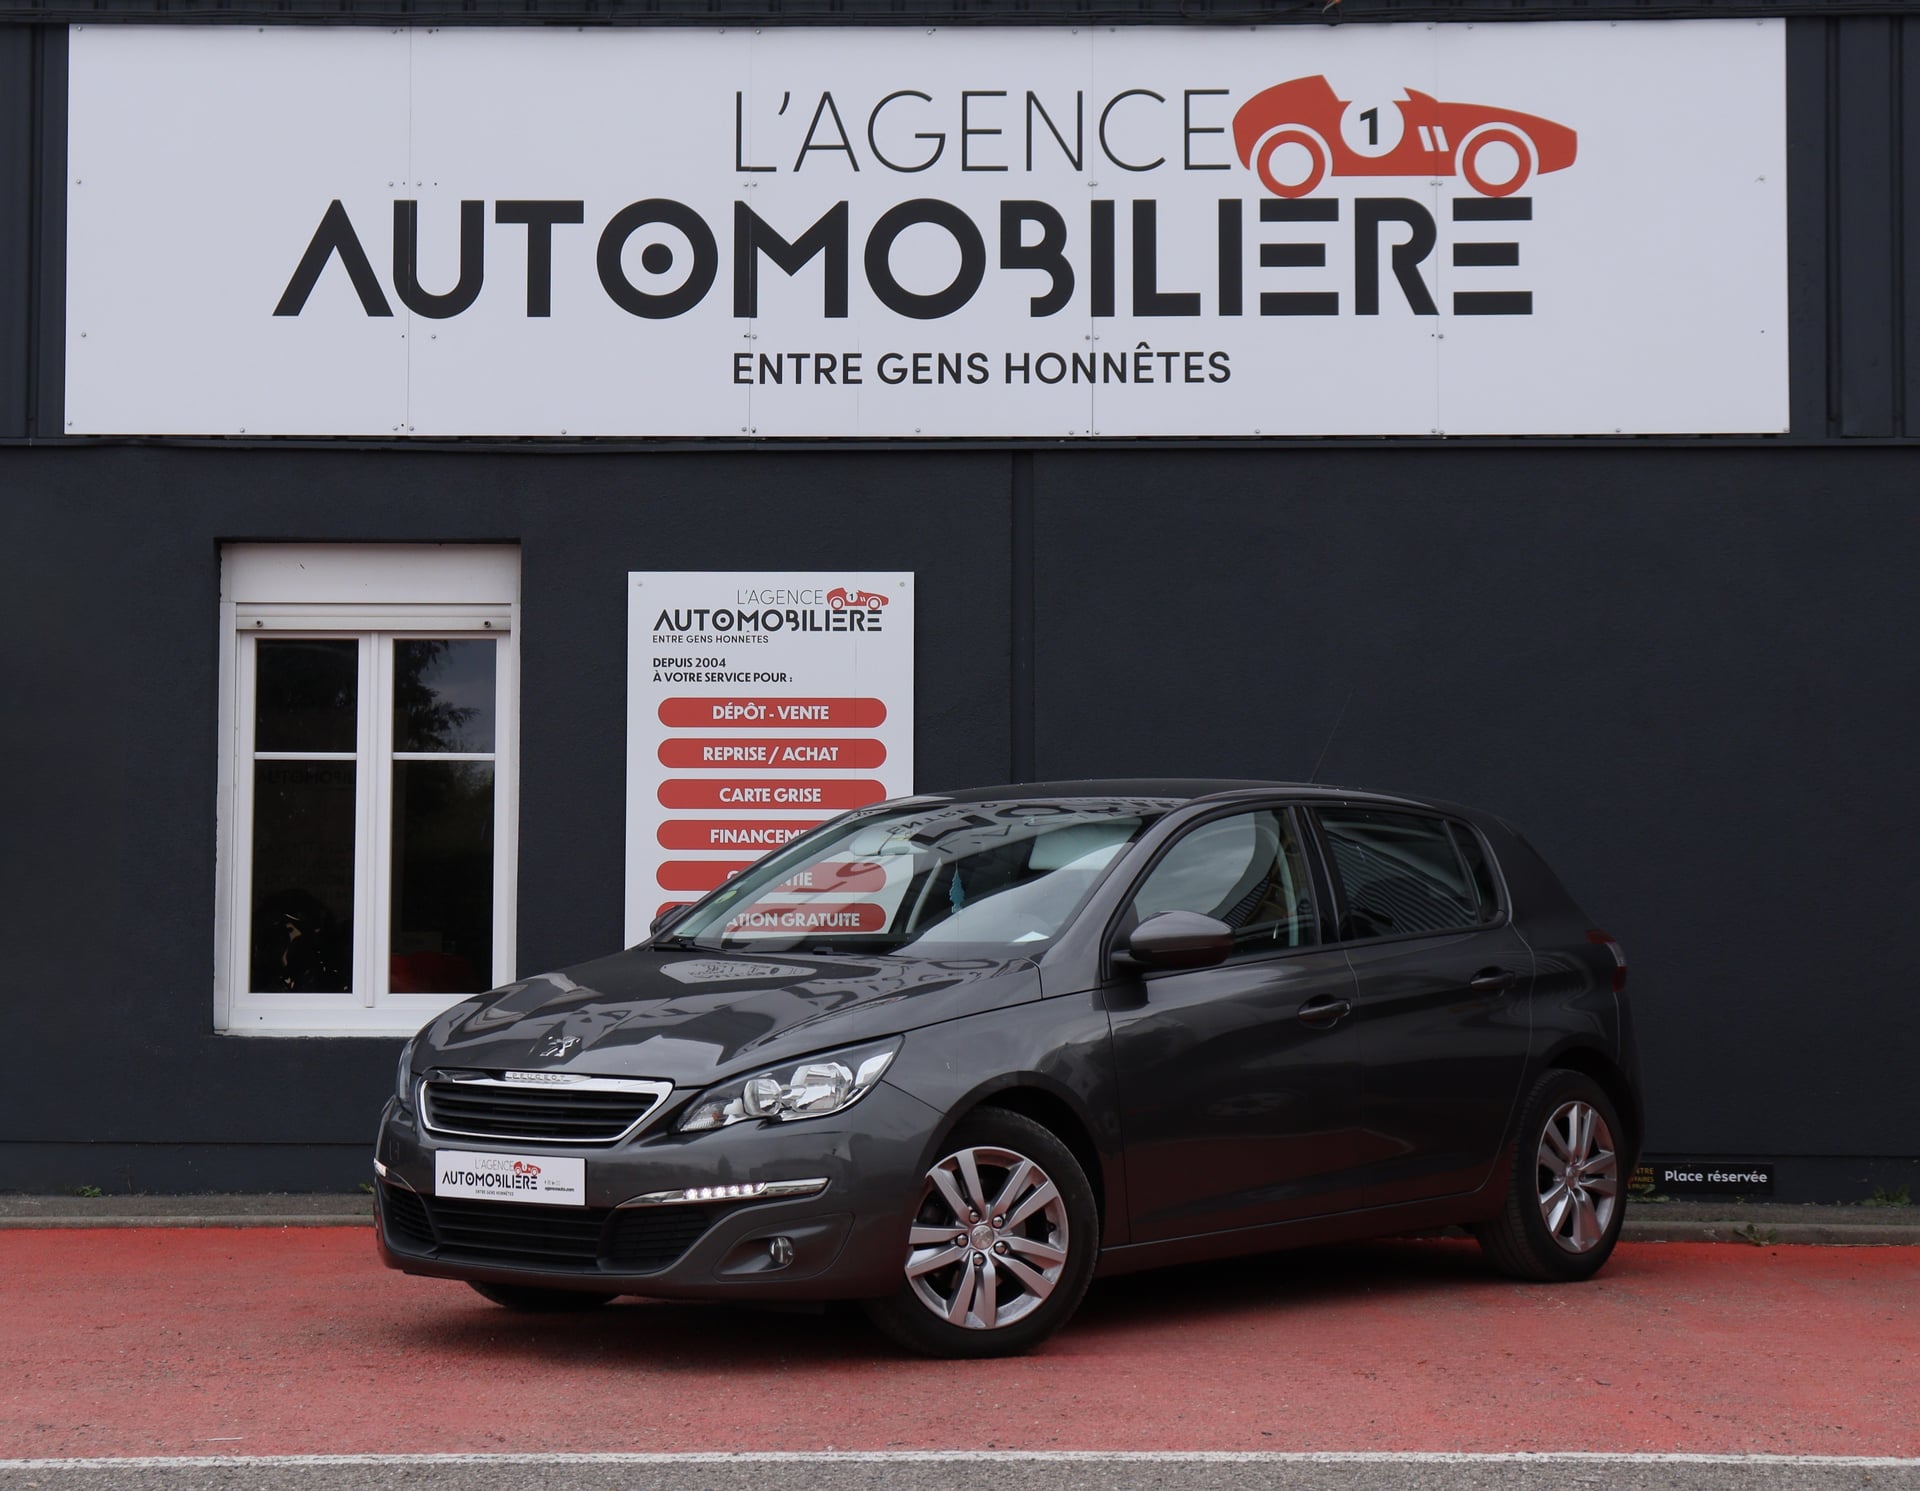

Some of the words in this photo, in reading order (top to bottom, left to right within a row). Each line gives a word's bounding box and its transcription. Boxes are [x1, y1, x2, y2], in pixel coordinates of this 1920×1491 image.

[736, 88, 1232, 173] L'AGENCE
[1361, 108, 1379, 145] 1
[273, 197, 1533, 319] AUTOMOBILIERE
[734, 353, 862, 385] ENTRE
[877, 353, 989, 385] GENS
[1006, 342, 1231, 385] HONNÊTES
[737, 589, 824, 605] L'AGENCE
[653, 608, 883, 632] AUTOMOBILIERE
[652, 634, 684, 644] ENTRE
[686, 634, 713, 644] GENS
[715, 631, 769, 644] HONNÊTES
[652, 657, 693, 668] DEPUIS
[695, 657, 727, 668] 2004
[652, 669, 662, 683] À
[664, 671, 703, 683] VOTRE
[704, 671, 752, 683] SERVICE
[753, 671, 787, 683] POUR
[712, 702, 767, 720] DÉPÔT
[777, 705, 830, 720] VENTE
[703, 746, 767, 761] REPRISE
[768, 746, 779, 765] /
[782, 746, 839, 761] ACHAT
[719, 787, 771, 803] CARTE
[773, 787, 822, 803] GRISE
[710, 829, 808, 844] FINANCEM
[781, 912, 860, 927] GRATUITE
[512, 1073, 566, 1082] PEUGEOT
[442, 1171, 537, 1189] AUTOMOBILIERE
[1665, 1170, 1703, 1182] Place
[1707, 1169, 1768, 1183] réservée
